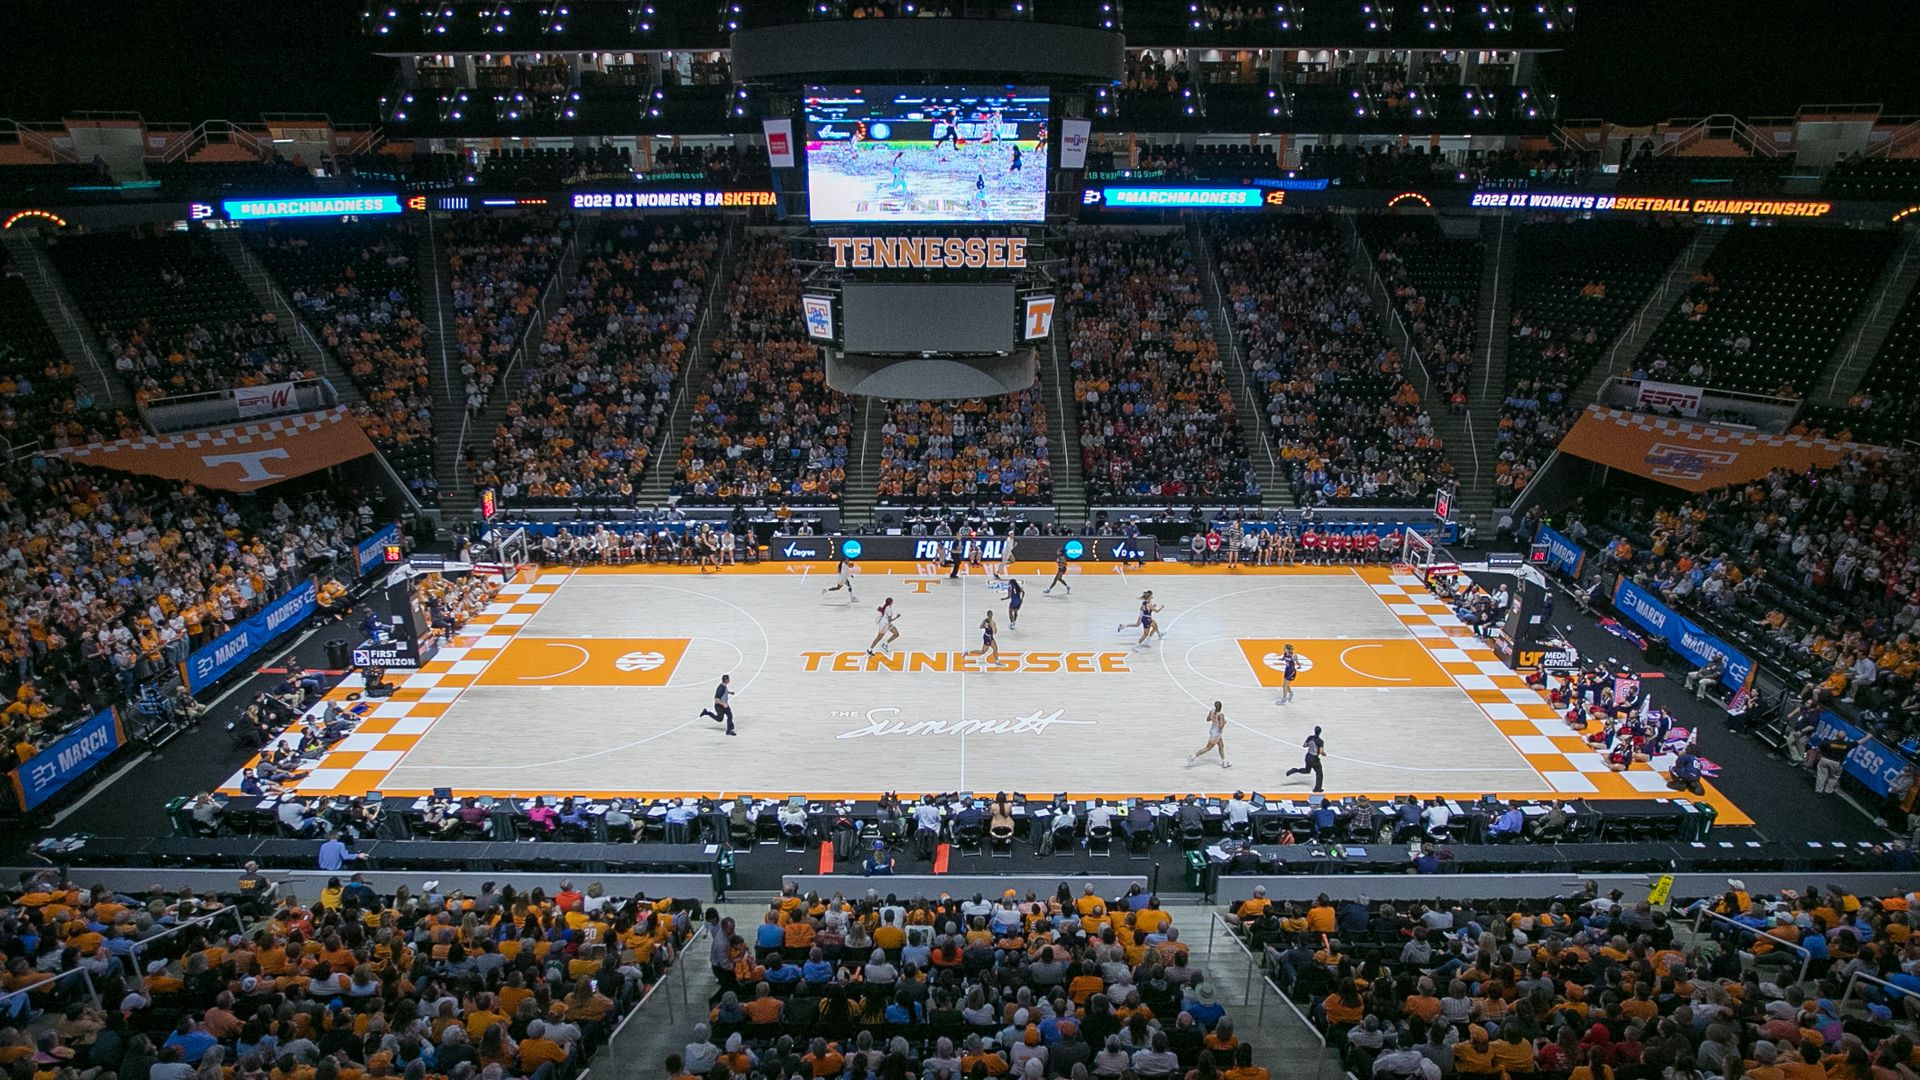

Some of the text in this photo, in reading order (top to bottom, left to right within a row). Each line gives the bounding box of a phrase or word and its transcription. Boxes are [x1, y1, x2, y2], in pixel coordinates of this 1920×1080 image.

[240, 199, 384, 216] #MARCHMADNESS
[574, 194, 612, 207] 2022
[614, 194, 633, 207] DI
[636, 192, 701, 207] WOMEN'S
[1117, 191, 1247, 204] #MARCHMADNESS
[1472, 194, 1831, 216] 2022 DI WOMEN'S BASKETBALL CHAMPIONSHIP
[828, 237, 1027, 268] TENNESSEE
[1641, 389, 1699, 409] ESPN
[793, 549, 816, 557] Degree
[1551, 541, 1577, 565] MARCH
[1635, 599, 1666, 629] MARCH
[214, 594, 303, 666] MARCH MADNESS
[371, 650, 397, 658] FIRST
[799, 651, 1134, 672] TENNESSEE
[1544, 659, 1573, 667] CENTER
[58, 725, 108, 773] MARCH
[584, 928, 597, 940] 20
